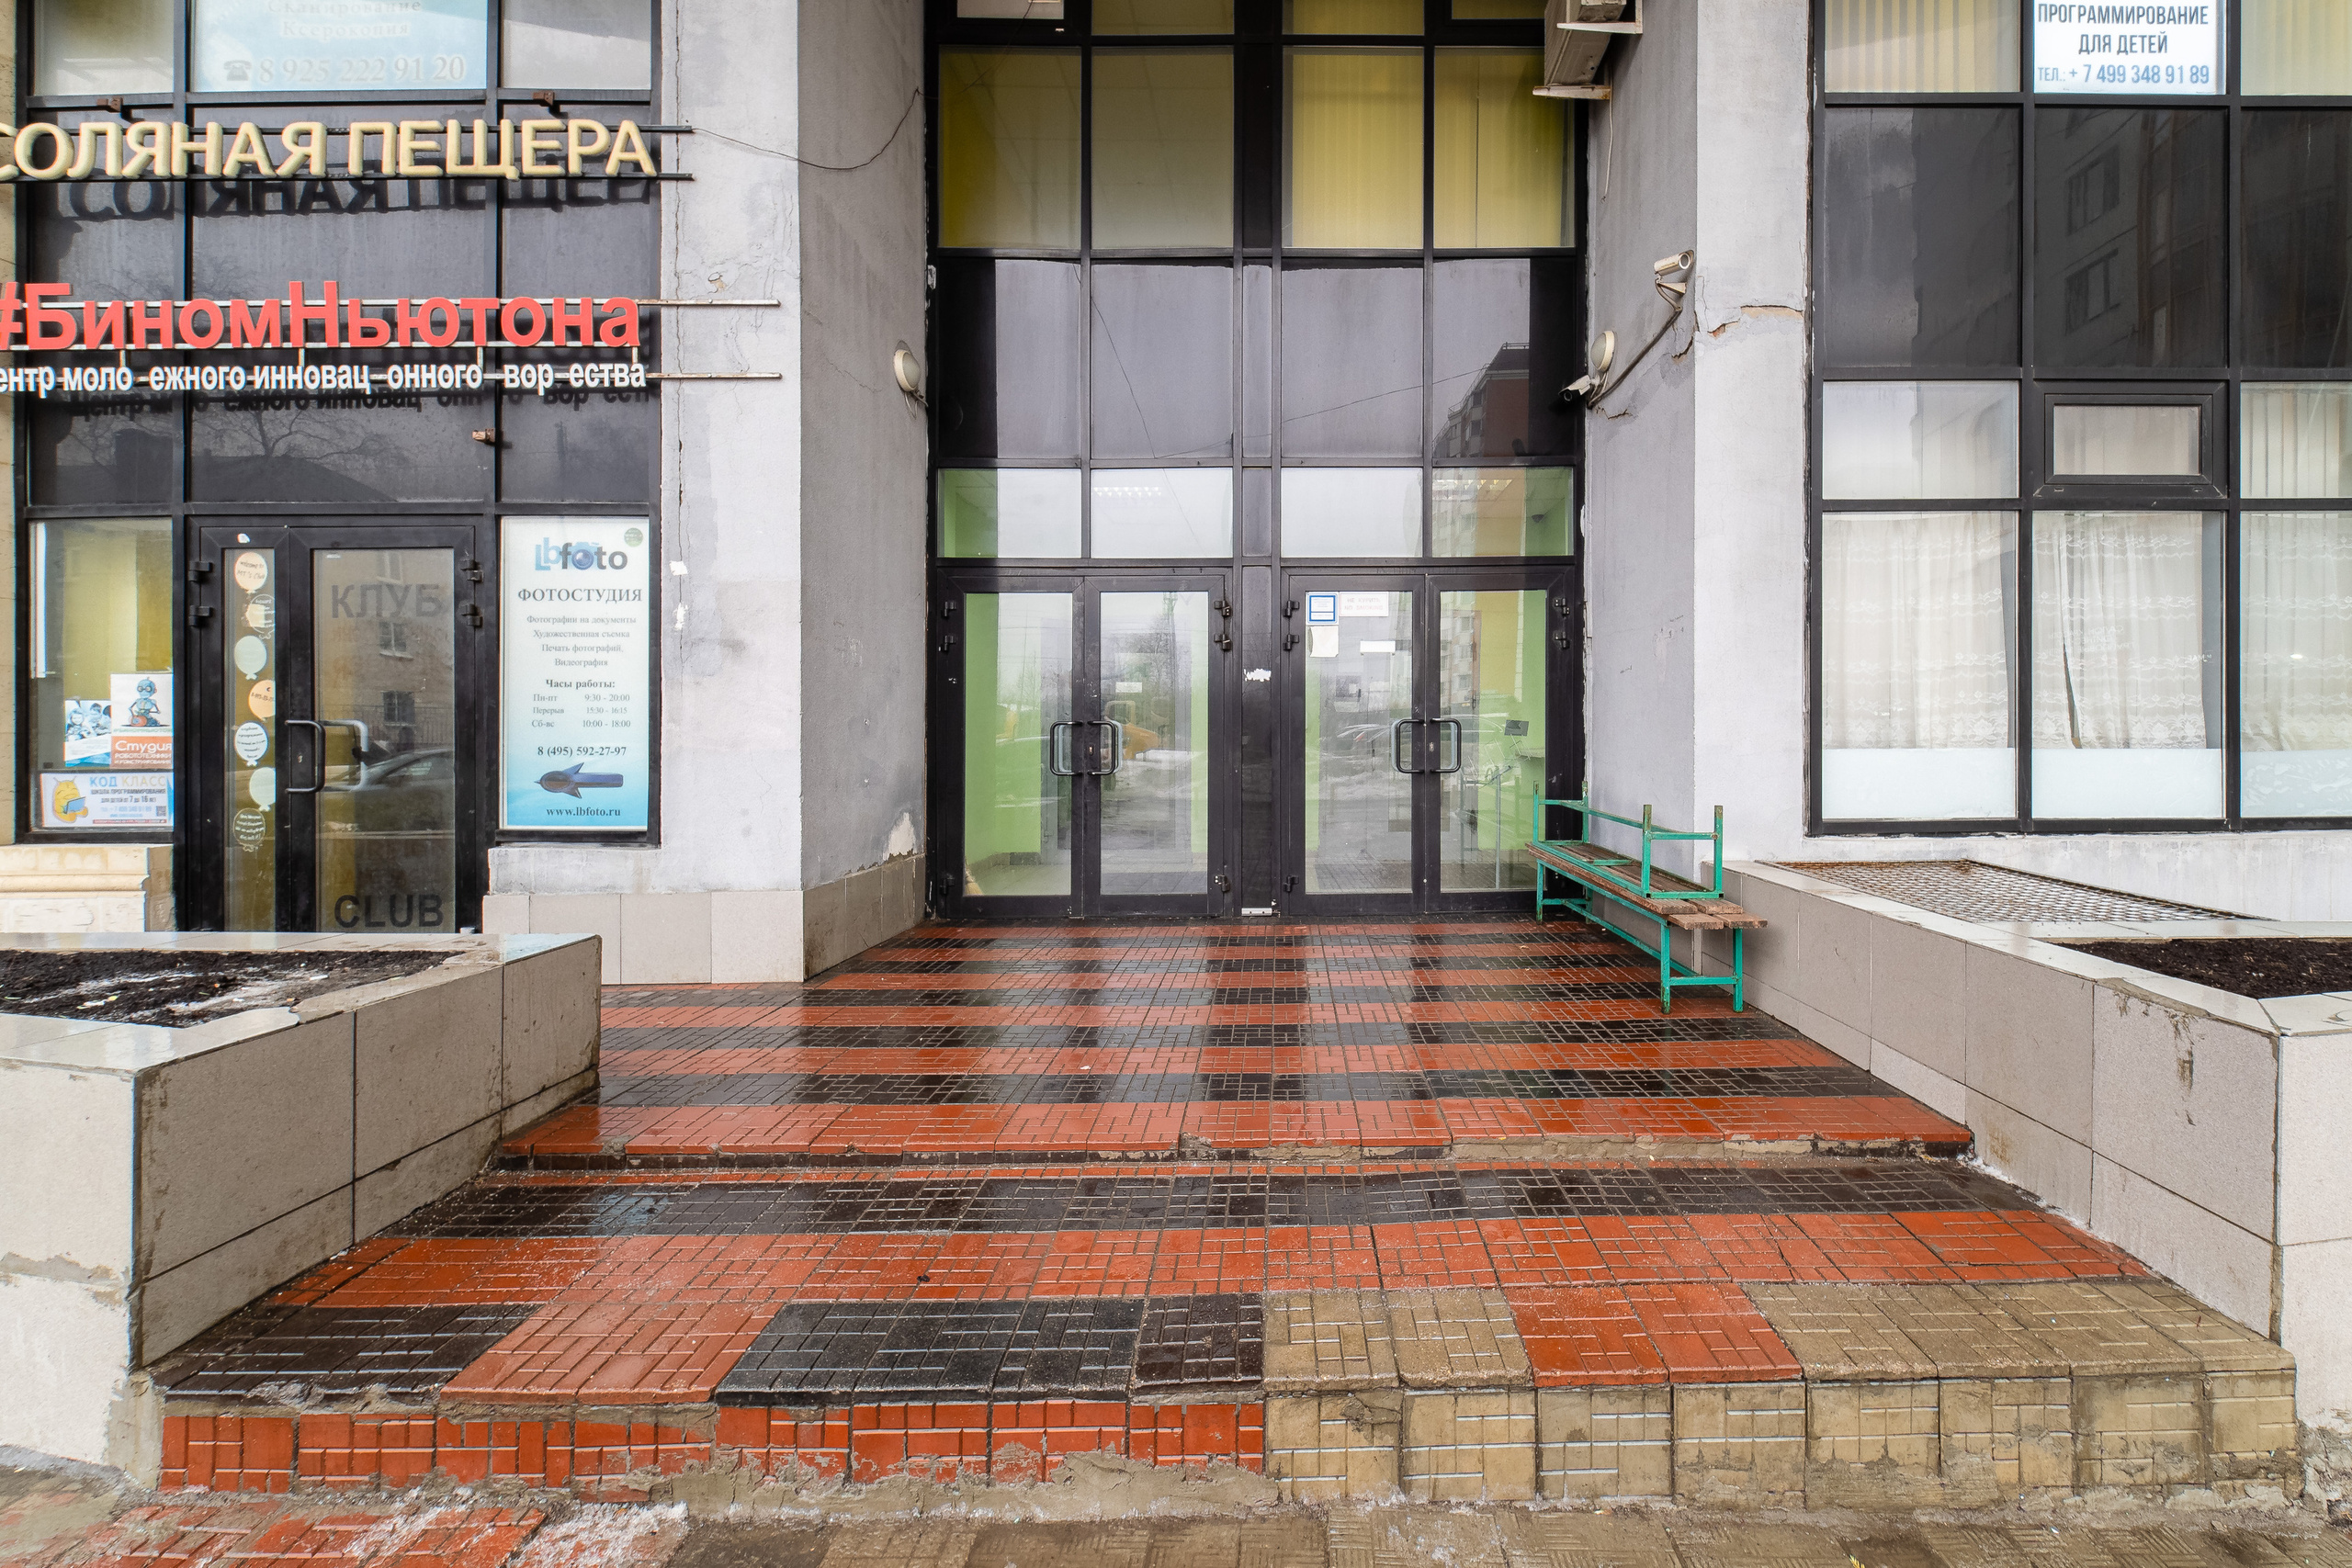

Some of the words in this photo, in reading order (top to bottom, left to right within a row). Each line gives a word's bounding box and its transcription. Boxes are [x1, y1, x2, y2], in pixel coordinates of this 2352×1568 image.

[2038, 4, 2209, 25] ПРОГРАММИРОВАНИЕ
[282, 21, 410, 41] Ксерокопия
[2078, 34, 2111, 55] ДЛЯ
[2116, 31, 2168, 55] ДЕТЕЙ
[259, 58, 274, 83] 8
[282, 58, 330, 83] 925
[339, 58, 385, 83] 222
[394, 57, 424, 81] 91
[433, 56, 465, 81] 20
[2038, 67, 2065, 82] ТЕЛ.:
[2083, 64, 2092, 83] 7
[2097, 65, 2126, 84] 499
[2132, 65, 2160, 84] 348
[2165, 65, 2184, 84] 91
[2189, 65, 2210, 85] 89
[348, 119, 658, 181] ПЕЩЕРА
[0, 280, 641, 351] #БиномНьютона
[331, 583, 446, 619] КЛУБ
[517, 588, 643, 604] ФОТОСТУДИЯ
[526, 615, 578, 626] Фотографии
[592, 616, 637, 626] документы
[533, 630, 599, 639] Художественная
[542, 644, 570, 652] Печать
[554, 658, 608, 669] Видеография
[546, 679, 572, 688] Часы
[575, 680, 616, 690] работы:
[533, 694, 558, 702] Пн-пт
[584, 694, 601, 703] 9:30
[609, 694, 630, 703] 20:00
[533, 707, 565, 716] Перерыв
[582, 720, 603, 728] 10:00
[611, 720, 631, 728] 18:00
[115, 740, 172, 754] Студия
[537, 746, 544, 756] 8
[547, 746, 573, 758] (495)
[576, 746, 627, 756] 592-27-97
[90, 776, 118, 787] КОД
[122, 775, 165, 787] КЛАСС
[546, 807, 621, 817] www.lbfoto.ru
[334, 894, 445, 928] CLUB
